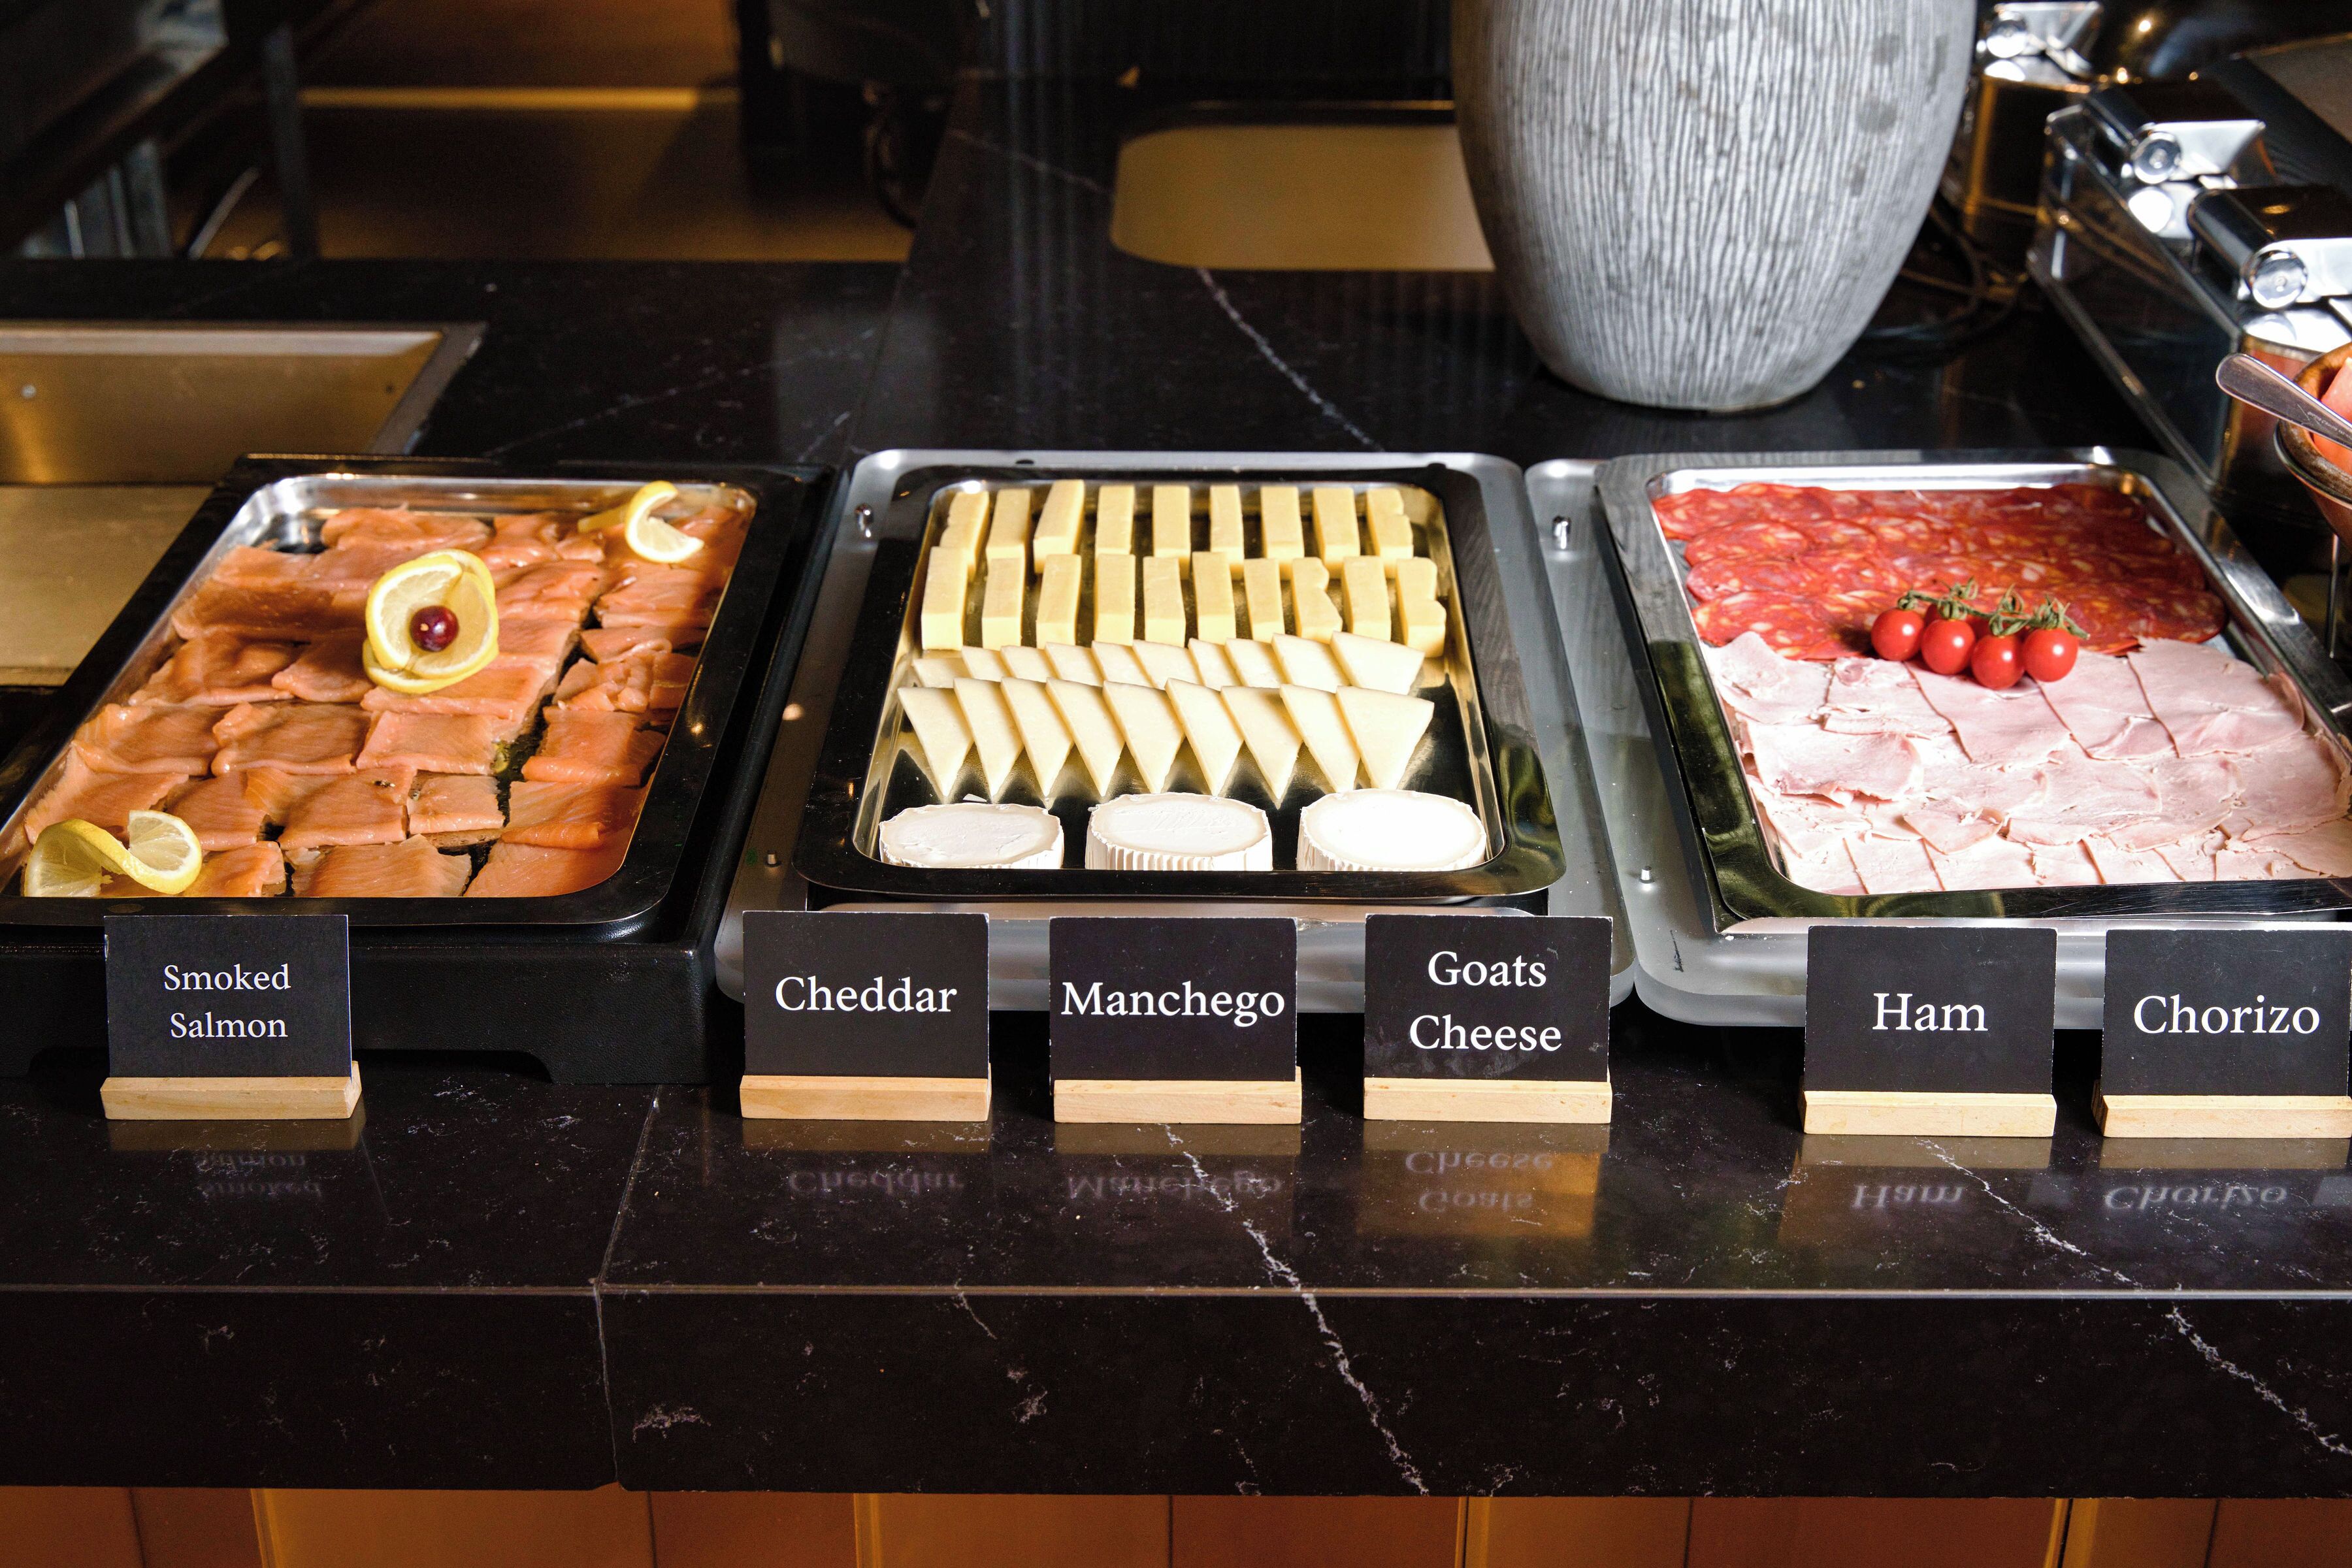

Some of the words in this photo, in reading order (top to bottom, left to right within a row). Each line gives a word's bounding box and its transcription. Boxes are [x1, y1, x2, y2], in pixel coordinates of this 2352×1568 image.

[163, 962, 292, 991] Smoked
[1427, 950, 1548, 988] Goats
[774, 974, 958, 1013] Cheddar
[1060, 979, 1286, 1028] Manchego
[1871, 992, 1989, 1032] Ham
[169, 1011, 289, 1039] Salmon
[1409, 1013, 1563, 1053] Cheese
[2133, 992, 2321, 1035] Chorizo
